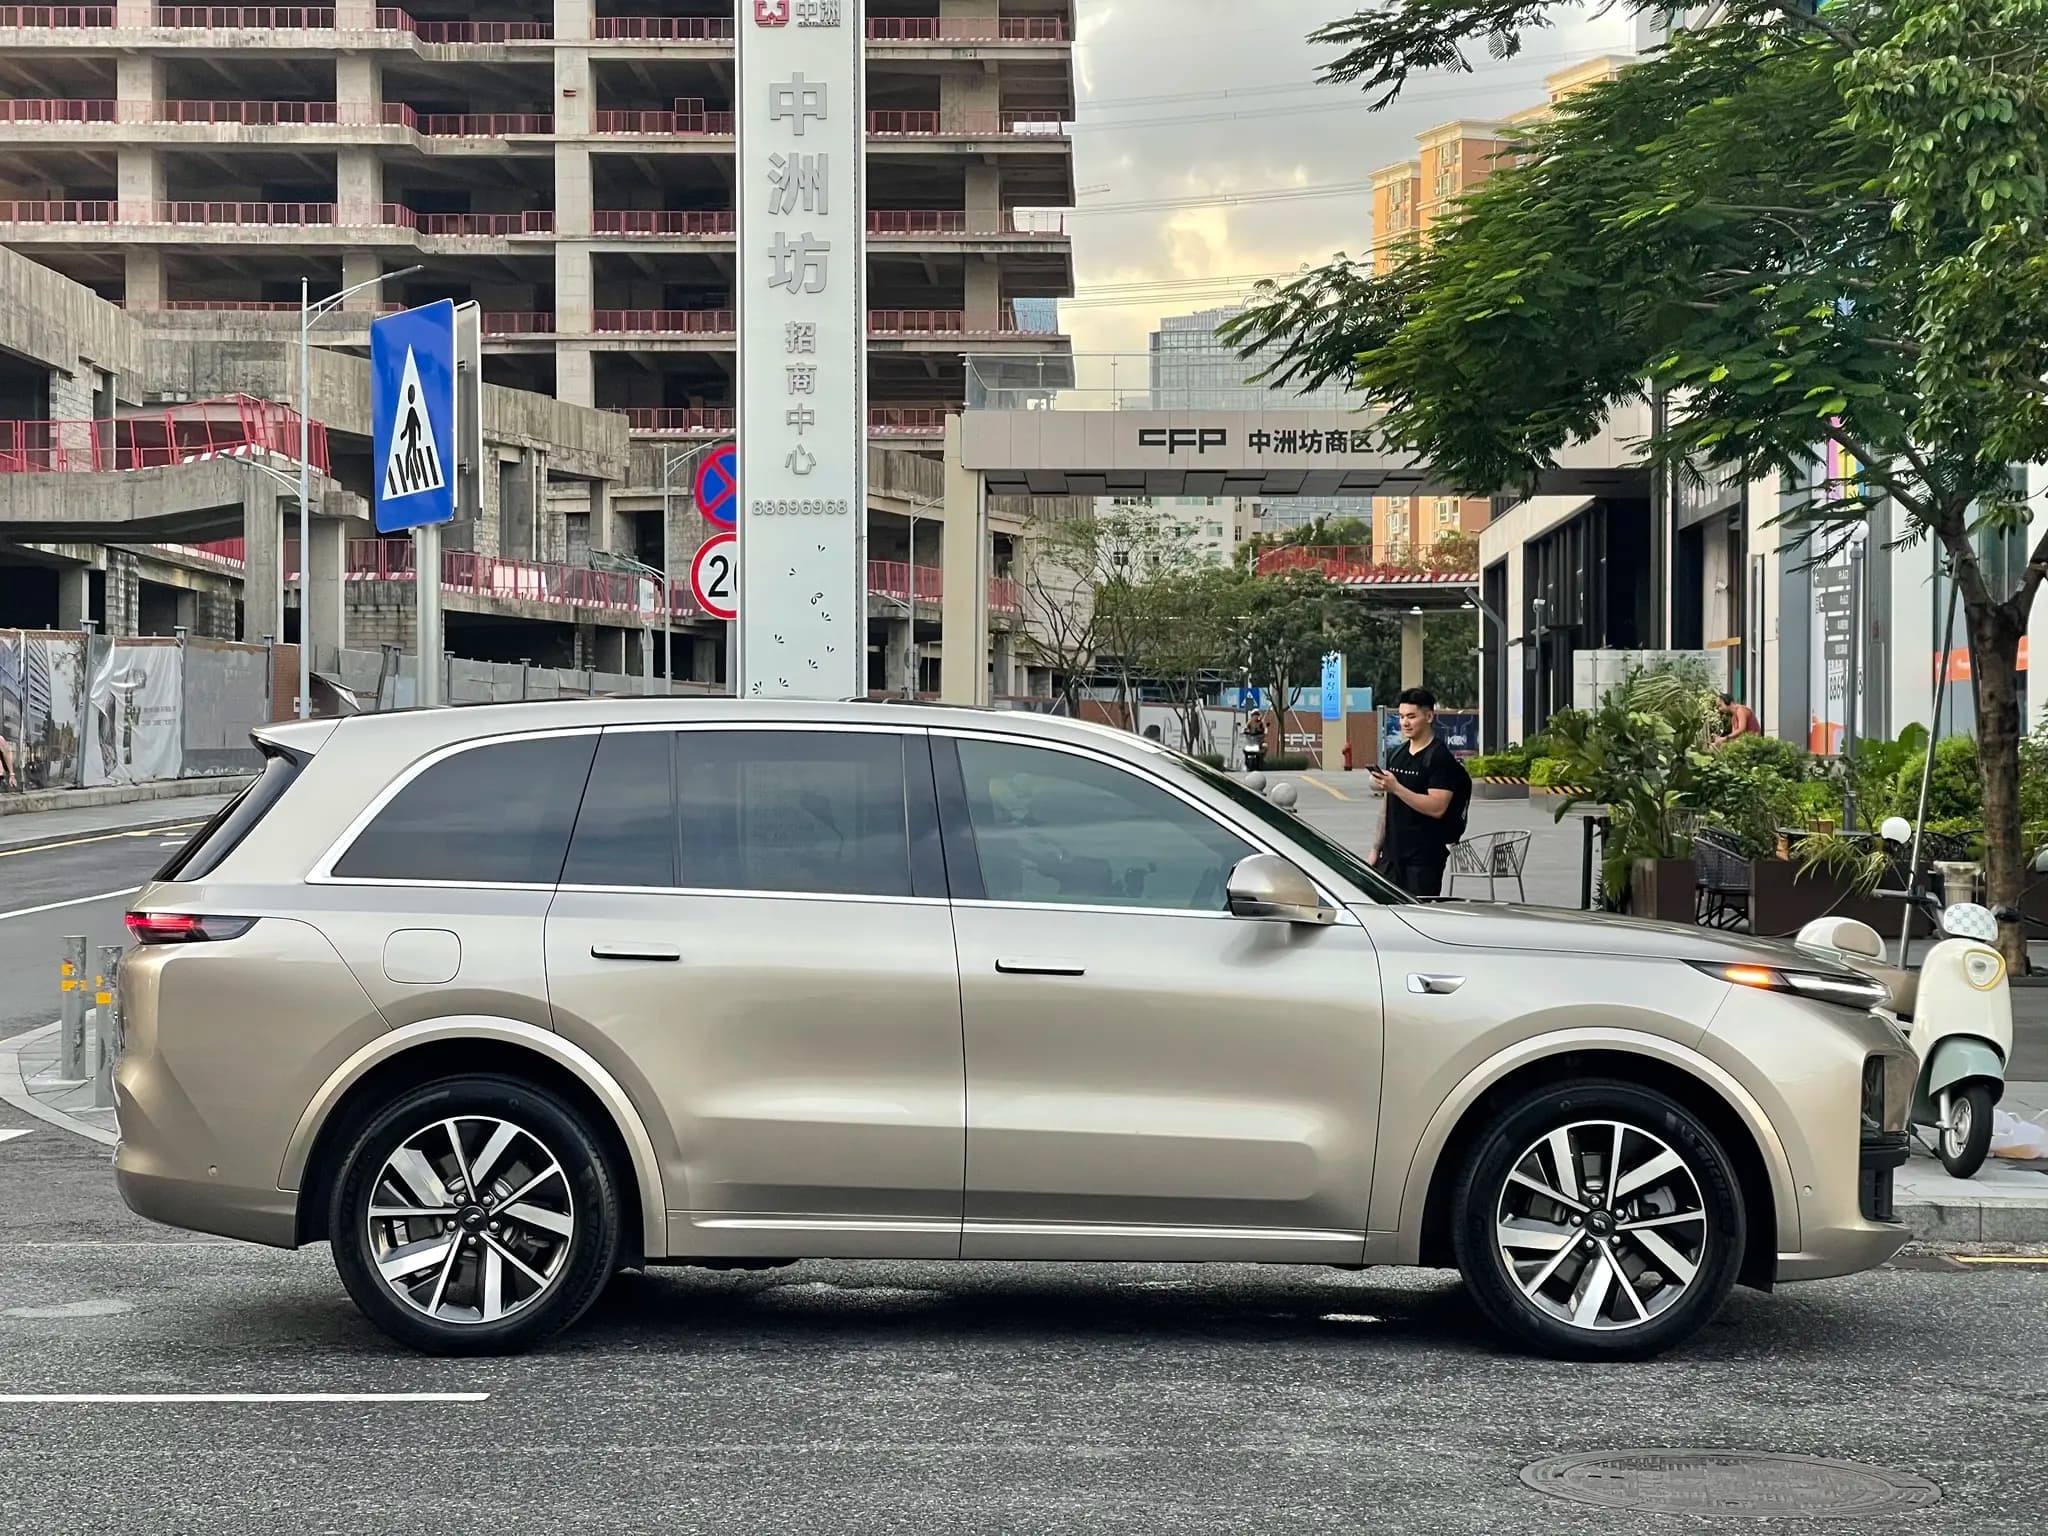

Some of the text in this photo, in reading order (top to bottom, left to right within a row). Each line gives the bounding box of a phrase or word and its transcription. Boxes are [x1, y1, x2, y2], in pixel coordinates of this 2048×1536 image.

[796, 0, 841, 21] 中洲
[767, 71, 831, 295] 中洲坊
[783, 319, 817, 476] 招商中心
[1248, 428, 1422, 454] 中洲坊商区入
[751, 498, 849, 516] 88696968
[708, 555, 737, 597] 2
